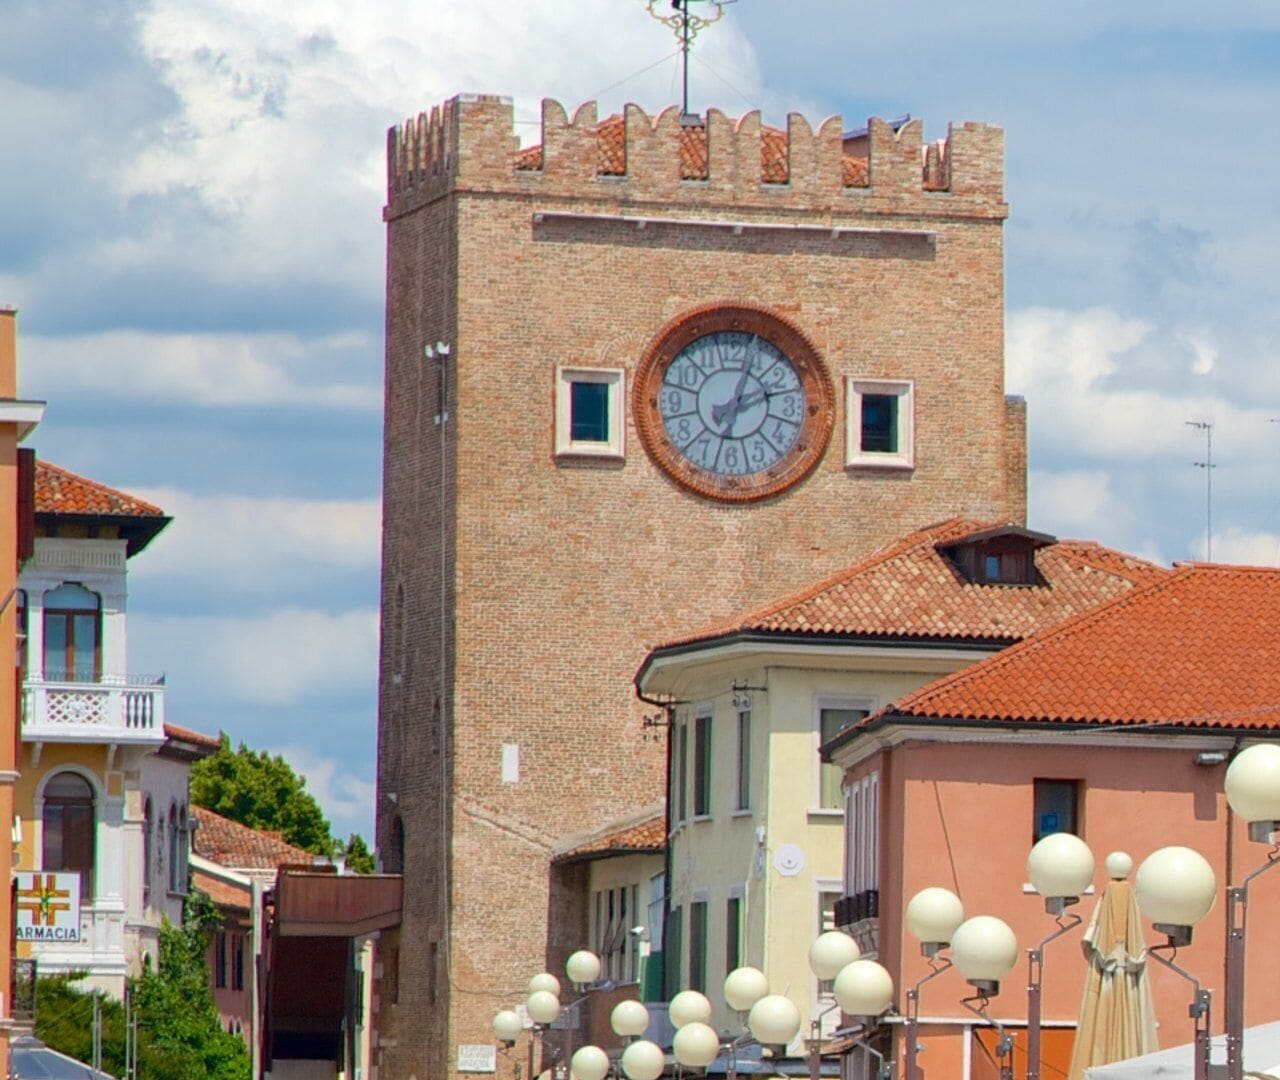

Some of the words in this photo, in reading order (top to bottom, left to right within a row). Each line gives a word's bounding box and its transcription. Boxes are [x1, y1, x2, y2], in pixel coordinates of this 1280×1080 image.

[700, 349, 715, 367] 11
[677, 365, 698, 386] 10
[772, 367, 787, 389] 2
[668, 391, 682, 412] 9
[783, 394, 796, 417] 3
[677, 418, 691, 441] 8
[771, 424, 785, 444] 4
[698, 440, 710, 462] 7
[725, 446, 738, 467] 6
[752, 441, 765, 463] 5
[16, 927, 77, 939] ARMACIA
